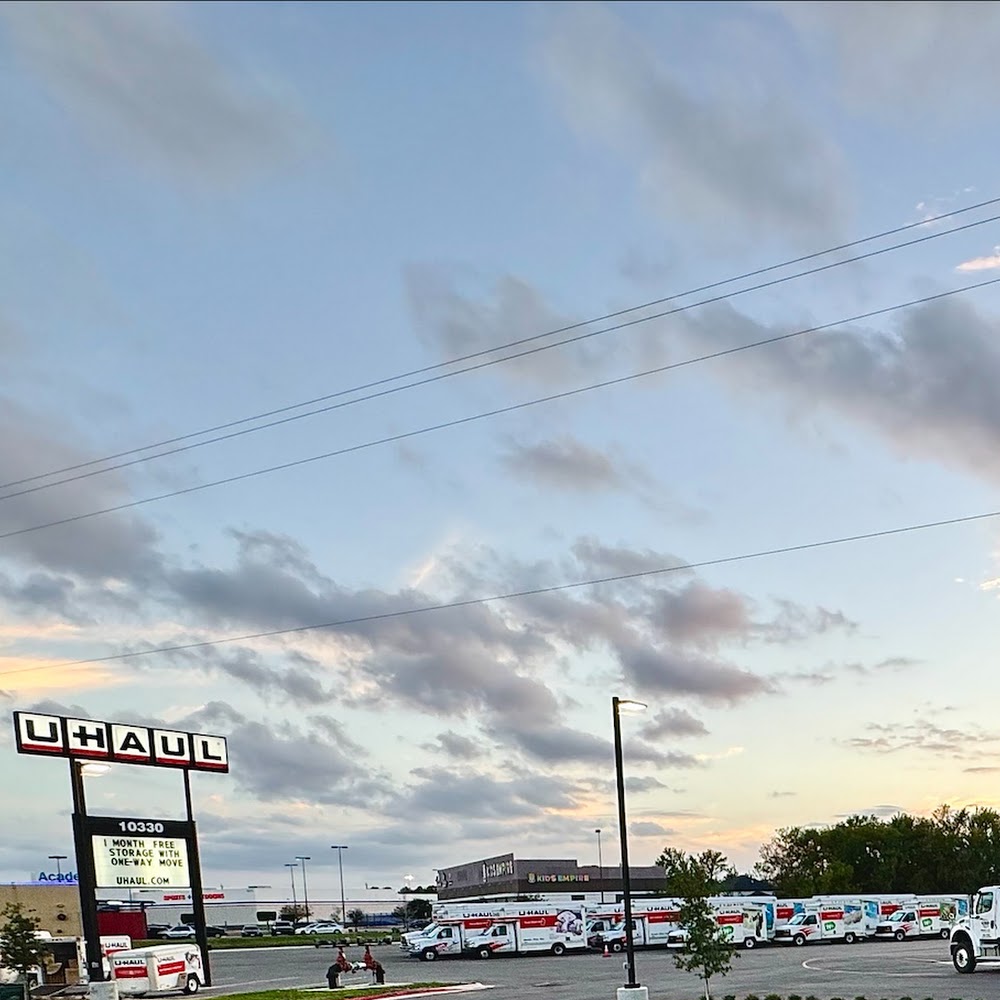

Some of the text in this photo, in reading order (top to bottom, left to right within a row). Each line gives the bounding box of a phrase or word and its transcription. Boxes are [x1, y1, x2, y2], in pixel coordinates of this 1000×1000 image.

[119, 821, 164, 833] 10330
[112, 839, 145, 847] MONTH
[153, 841, 175, 849] FREE
[109, 848, 180, 858] STORAGE WITH
[111, 857, 184, 868] ONE-WAY MOVE
[39, 871, 79, 883] Acade
[116, 876, 170, 885] UHAUL.COM
[537, 874, 590, 883] KIDS EMPIRE
